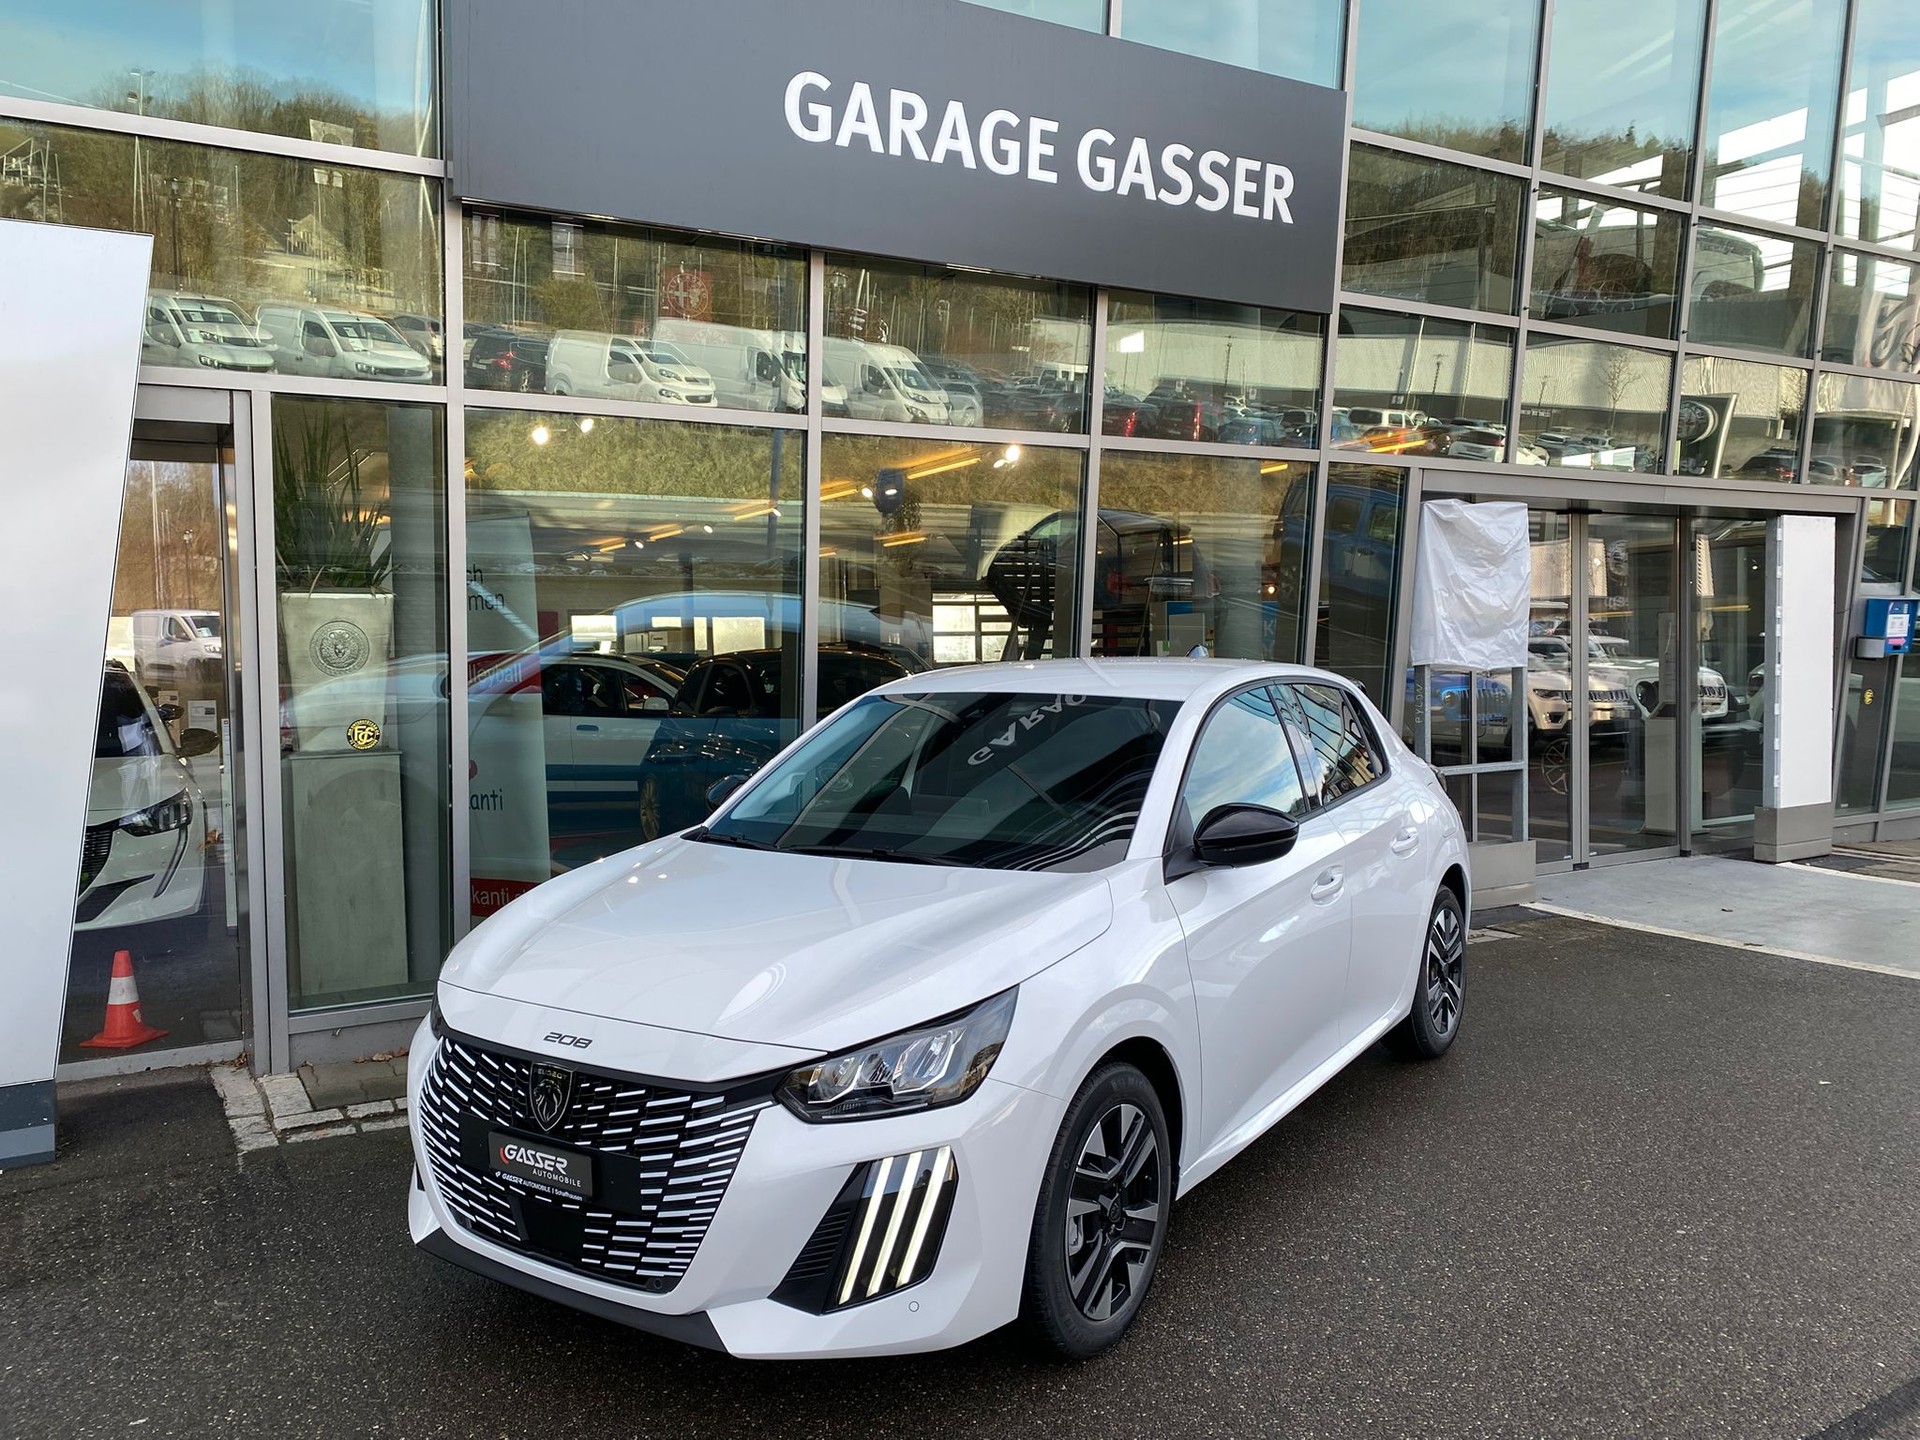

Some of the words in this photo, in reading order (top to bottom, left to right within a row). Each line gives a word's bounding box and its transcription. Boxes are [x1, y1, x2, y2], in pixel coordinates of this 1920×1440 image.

[785, 71, 1059, 185] GARAGE
[1077, 128, 1295, 225] GASSER
[469, 788, 503, 811] anti
[543, 1031, 593, 1049] 208
[504, 1144, 568, 1175] GASSER
[533, 1168, 581, 1188] AUTOMOBILE
